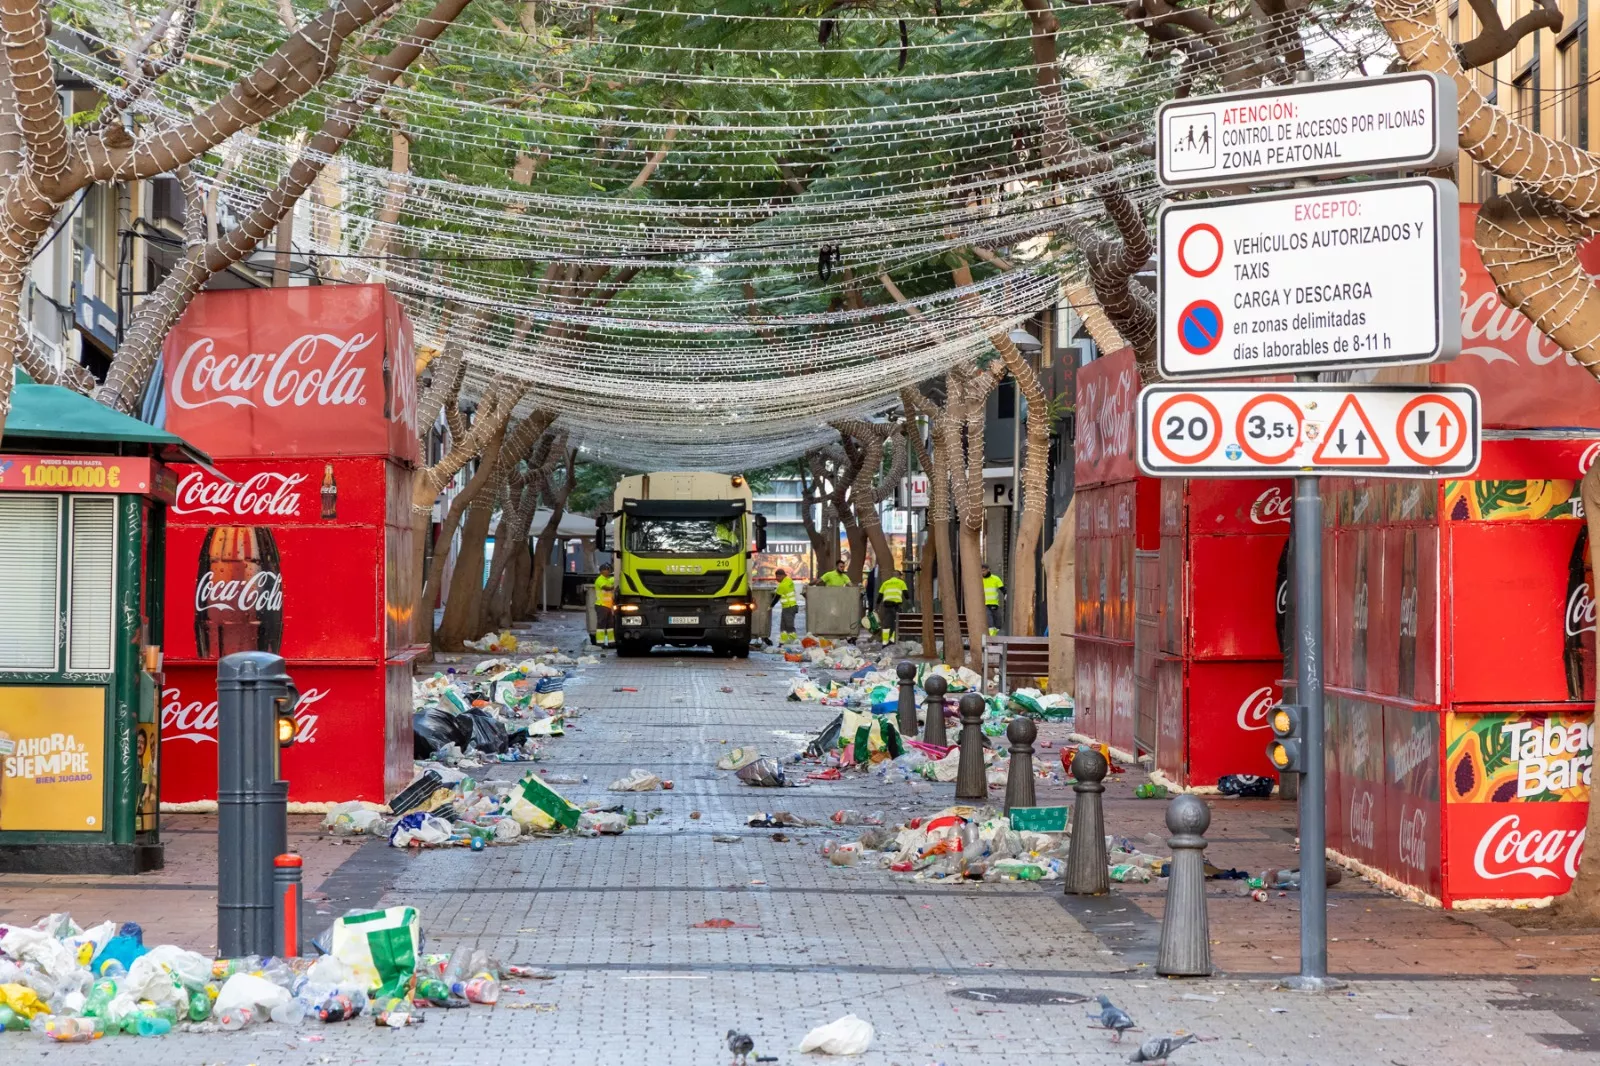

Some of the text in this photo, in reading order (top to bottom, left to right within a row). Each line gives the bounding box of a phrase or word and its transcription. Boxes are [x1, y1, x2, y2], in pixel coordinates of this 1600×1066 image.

[1222, 99, 1298, 126] ATENCIÓN:
[1222, 108, 1425, 147] CONTROL DE ACCESOS POR PILONAS
[1222, 141, 1341, 169] ZONA PEATONAL
[1295, 200, 1362, 221] EXCEPTO:
[1234, 221, 1424, 255] VEHÍCULOS AUTORIZADOS Y
[1234, 262, 1270, 281] TAXIS
[1234, 281, 1372, 309] CARGA Y DESCARGA
[1233, 310, 1366, 335] en zonas delimitadas
[1233, 333, 1391, 360] días laborables de 8-11 h
[171, 331, 378, 410] Coca-Cola
[1166, 416, 1208, 441] 20
[195, 571, 282, 612] Coca-Cola
[16, 733, 76, 757] AHORA
[5, 752, 89, 779] SIEMPRE
[58, 773, 93, 783] JUGADO
